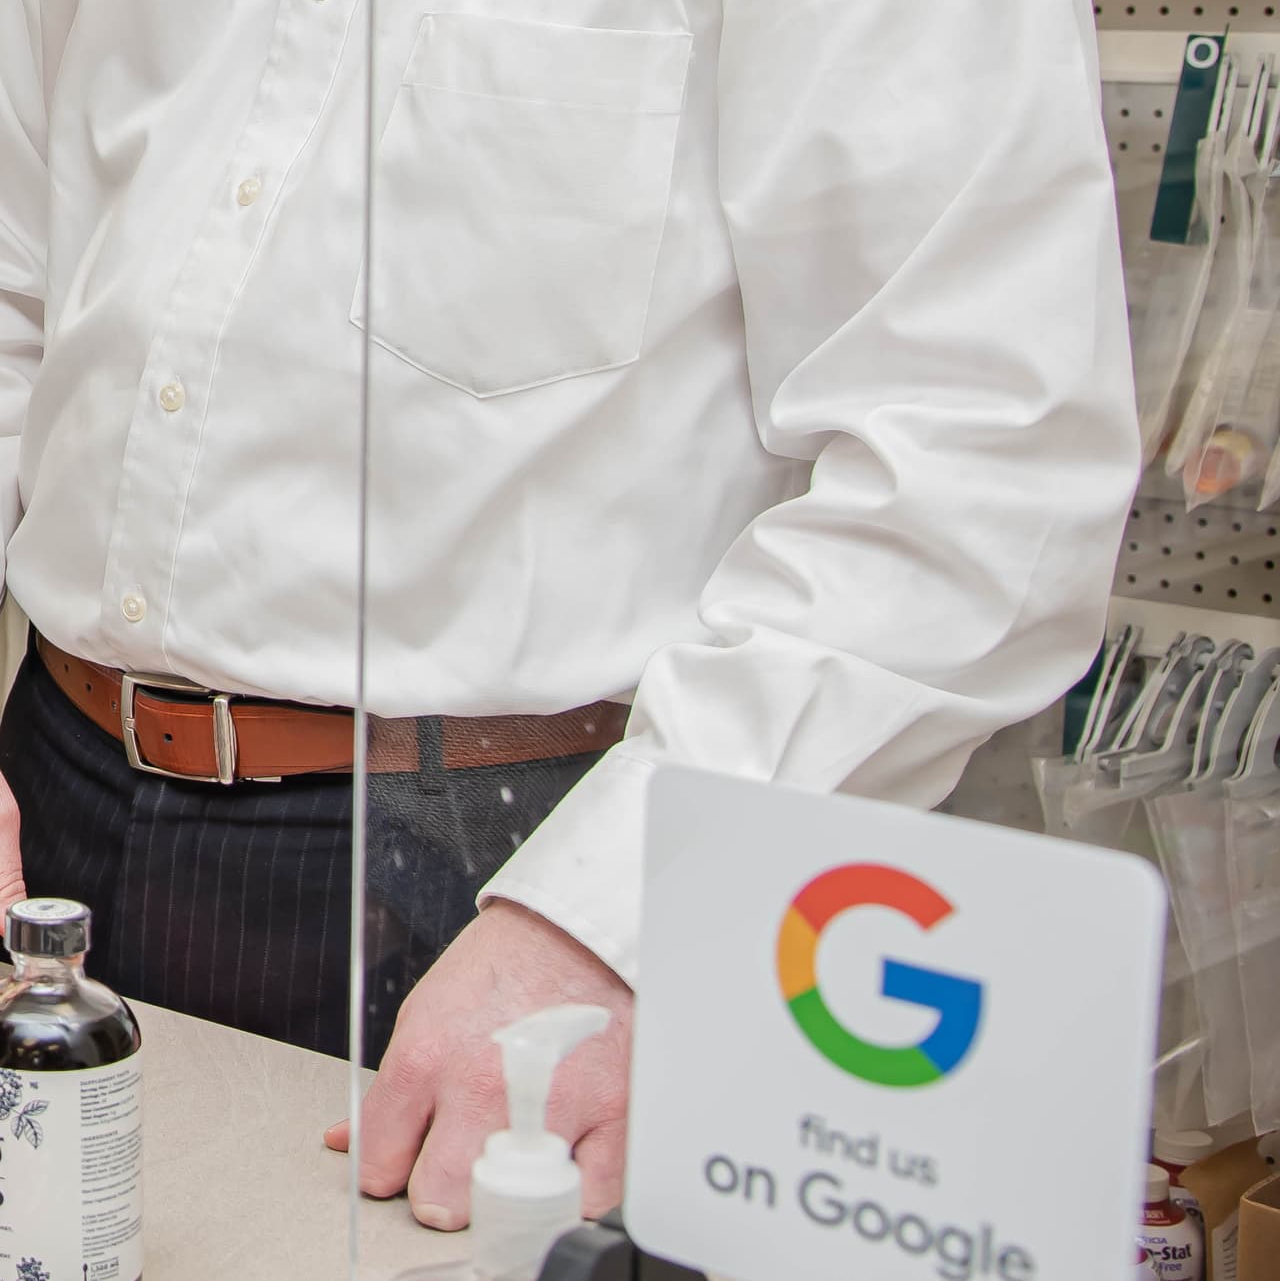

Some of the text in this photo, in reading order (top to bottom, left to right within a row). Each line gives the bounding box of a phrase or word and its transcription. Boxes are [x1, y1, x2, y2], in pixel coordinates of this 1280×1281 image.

[799, 1114, 938, 1187] find us
[703, 1154, 1037, 1281] on Google
